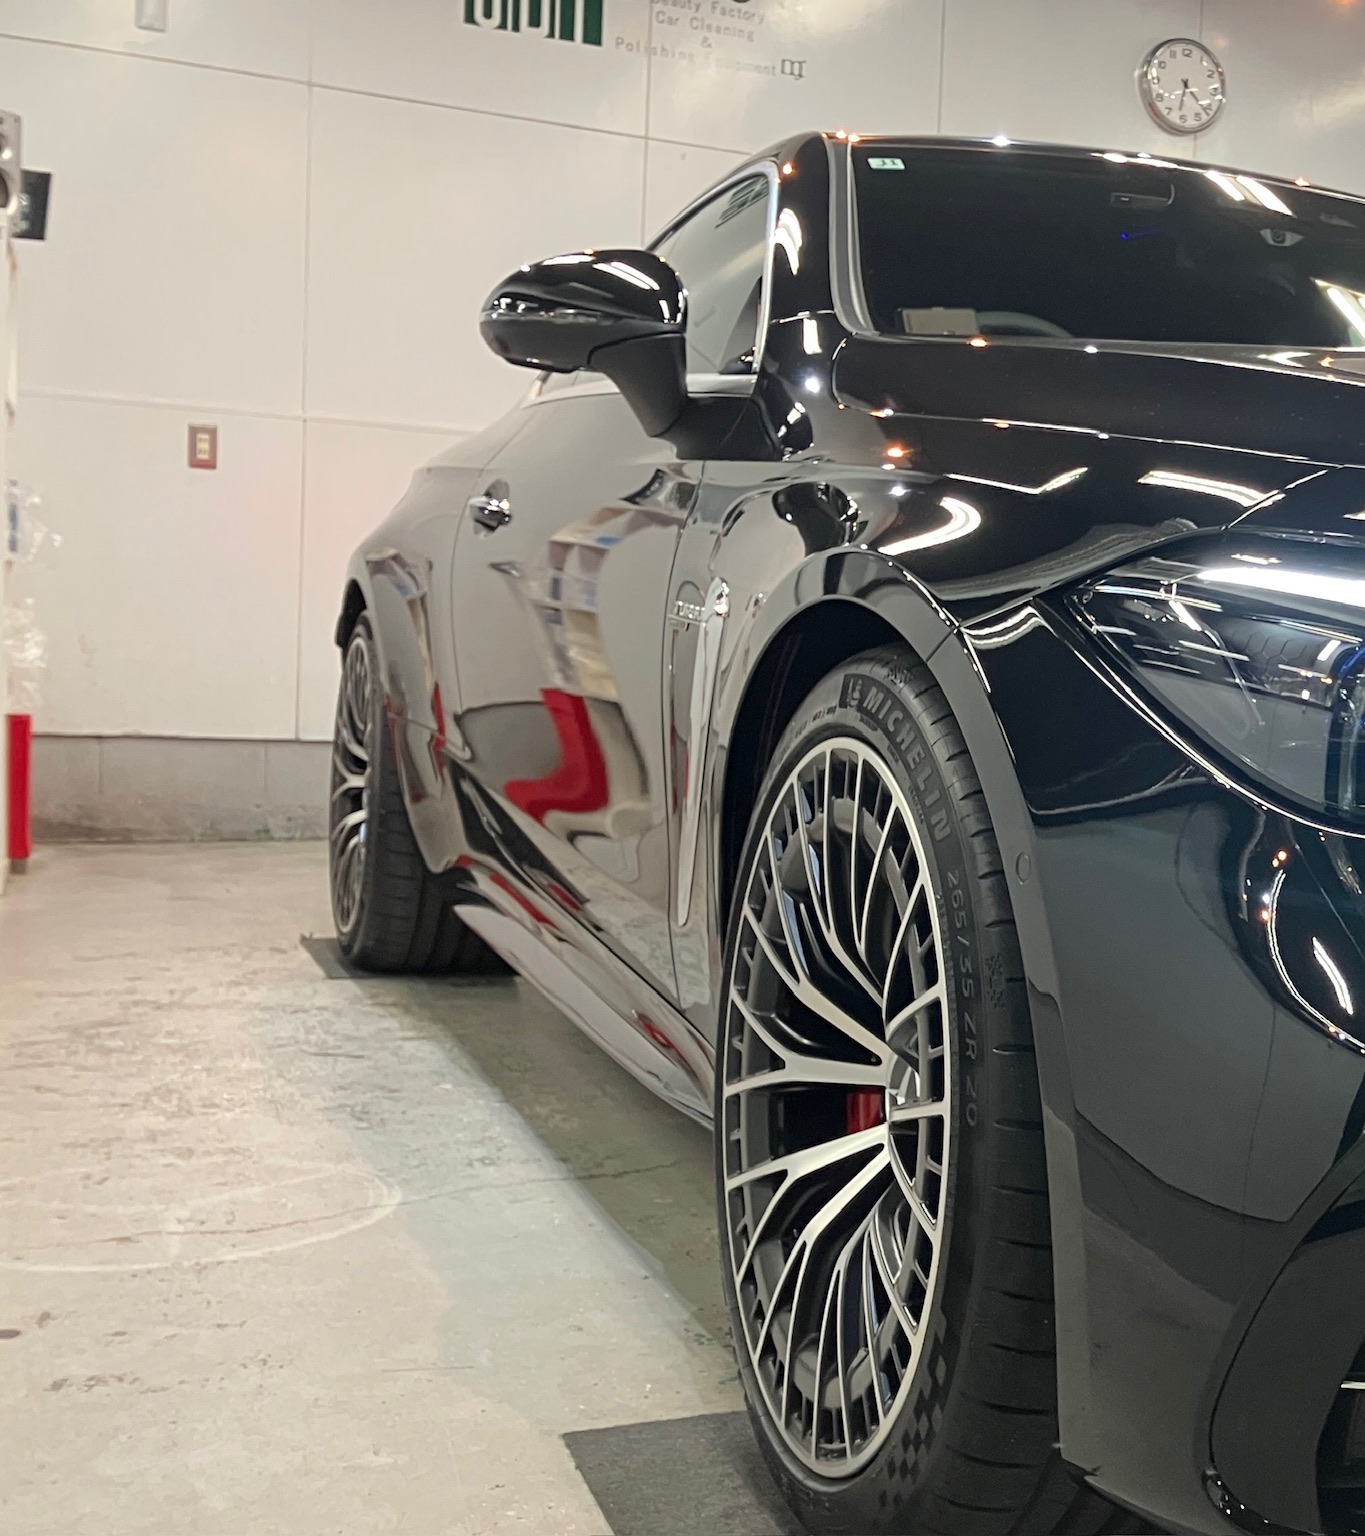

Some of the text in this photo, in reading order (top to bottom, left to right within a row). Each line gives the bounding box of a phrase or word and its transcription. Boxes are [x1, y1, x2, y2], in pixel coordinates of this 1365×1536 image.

[651, 0, 766, 25] eauty Factory
[655, 10, 755, 43] Car Cleaning
[700, 36, 713, 49] &
[1206, 69, 1215, 79] 2
[1164, 107, 1173, 116] 7
[1179, 114, 1187, 123] 6
[1193, 112, 1202, 122] 5
[863, 686, 951, 841] MICHELIN
[947, 871, 975, 999] 265/35
[963, 1011, 977, 1060] ZR
[965, 1074, 978, 1127] 20
